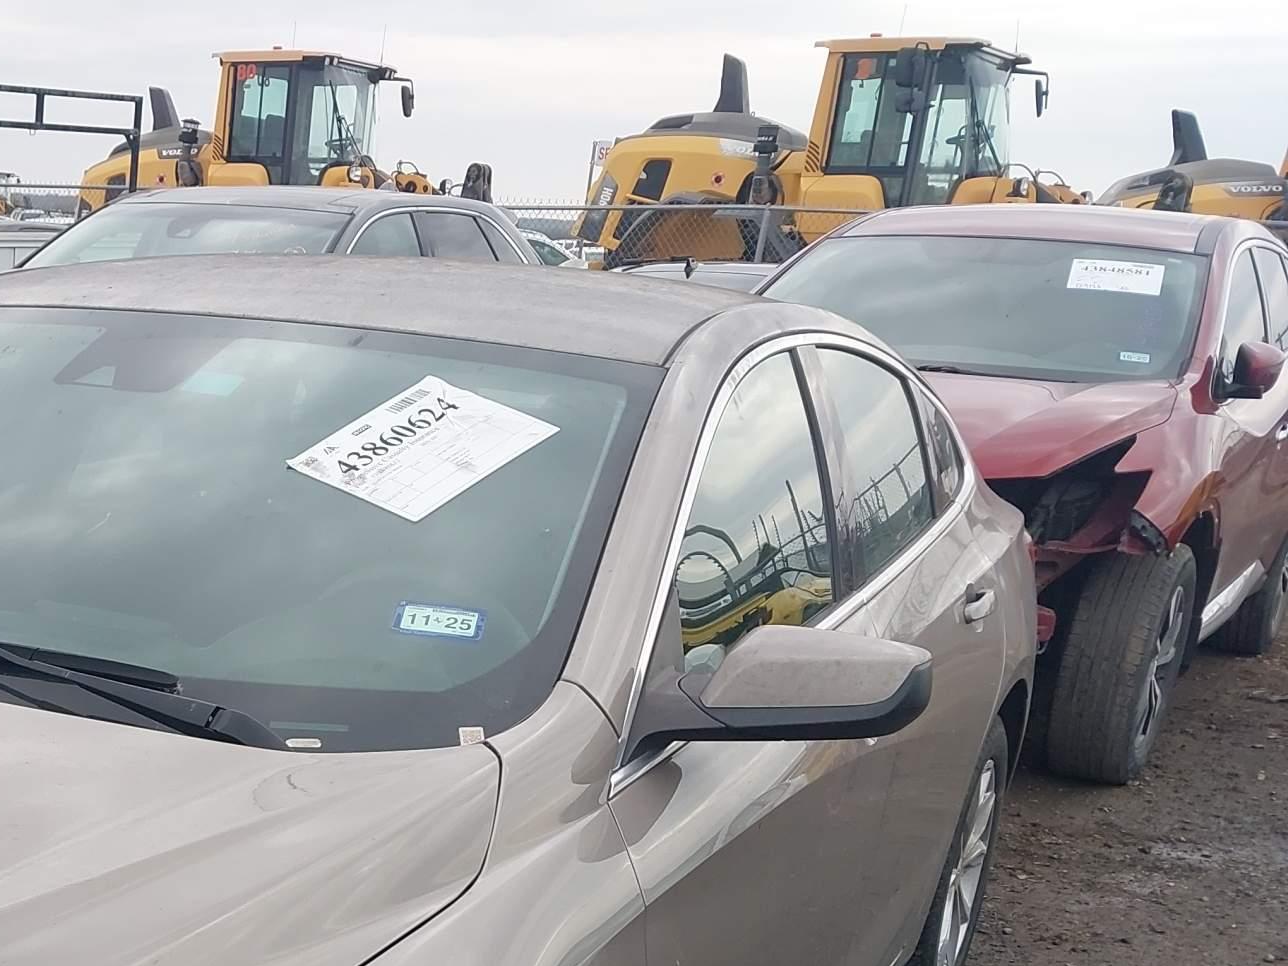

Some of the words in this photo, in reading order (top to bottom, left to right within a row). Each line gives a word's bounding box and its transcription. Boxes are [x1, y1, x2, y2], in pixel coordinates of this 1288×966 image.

[161, 148, 198, 156] VOLO
[1230, 185, 1283, 193] VOLVO
[337, 397, 460, 474] 43860624
